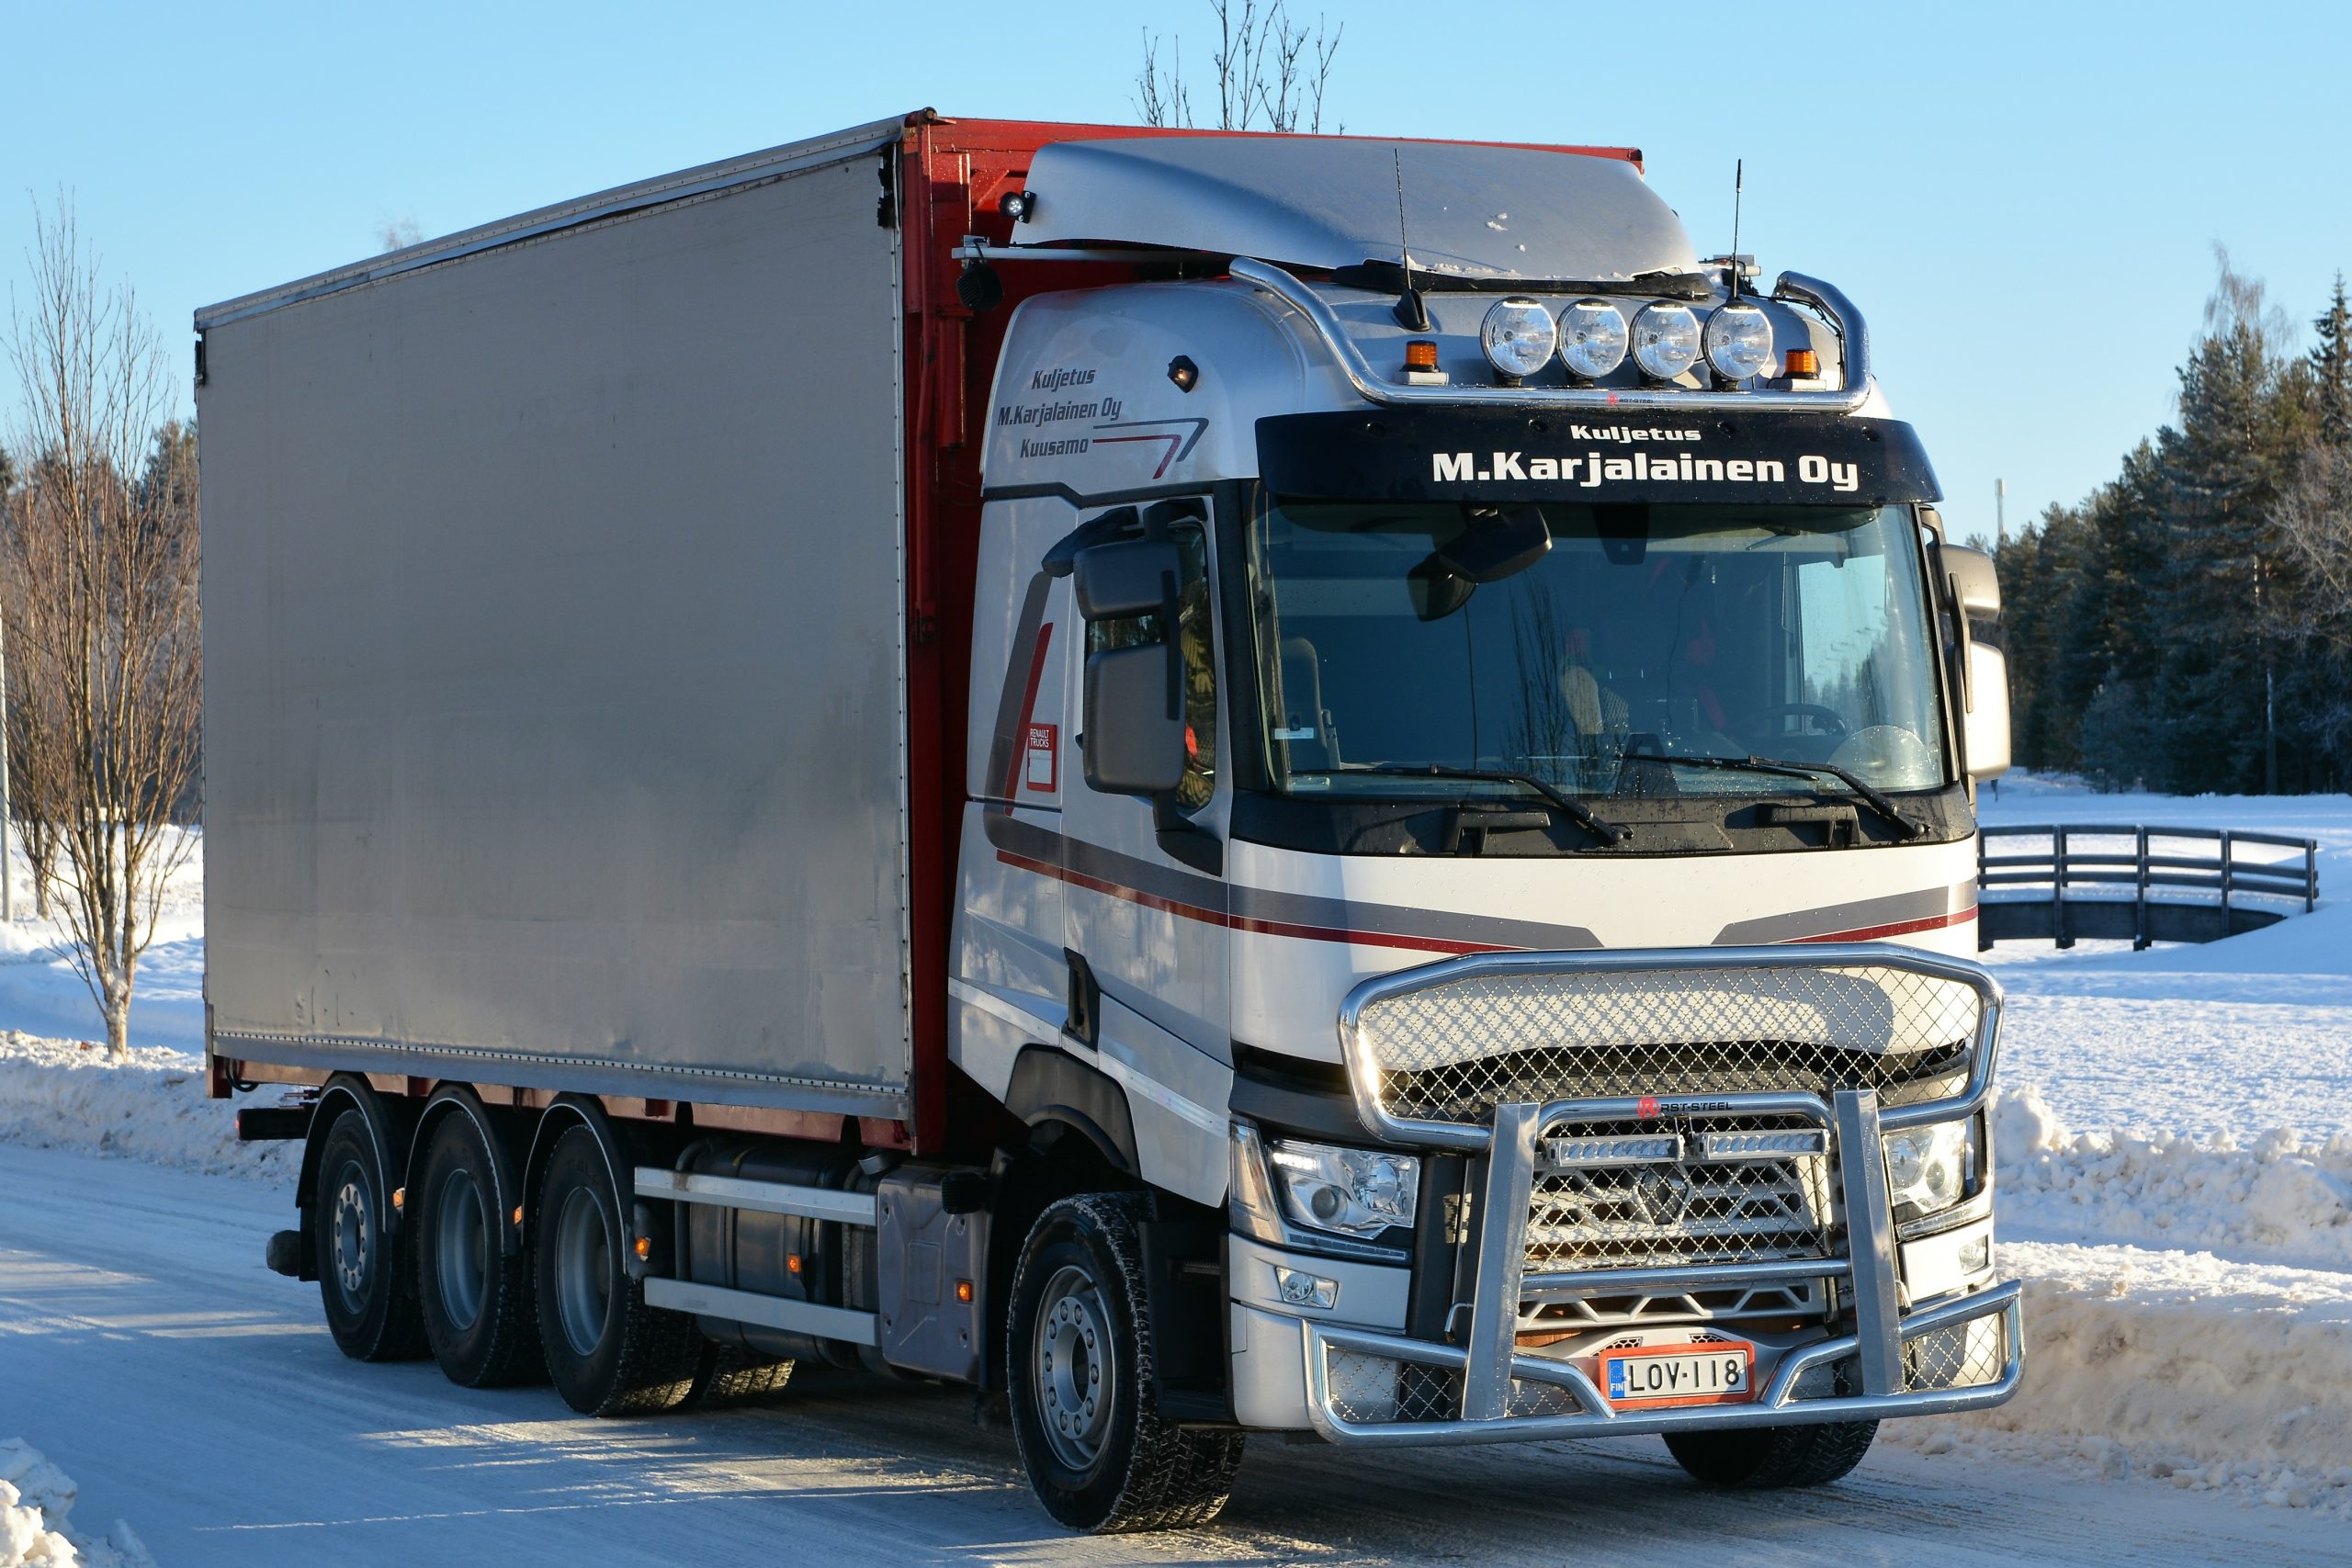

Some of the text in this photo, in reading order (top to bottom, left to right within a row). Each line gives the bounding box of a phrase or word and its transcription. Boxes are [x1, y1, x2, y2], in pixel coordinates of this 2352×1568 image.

[1031, 367, 1096, 392] Kuljetus
[998, 397, 1123, 427] M.Karjalainen Oy
[1570, 424, 1702, 444] Kuljetus
[1020, 437, 1089, 458] Kuusamo
[1432, 451, 1860, 491] M.Karjalainen Oy
[1030, 728, 1049, 739] RENAULT
[1030, 738, 1049, 748] TRUCKS
[1660, 1102, 1733, 1111] RST-STEEL
[1630, 1359, 1739, 1391] LOV-118
[1610, 1382, 1624, 1392] FIN
